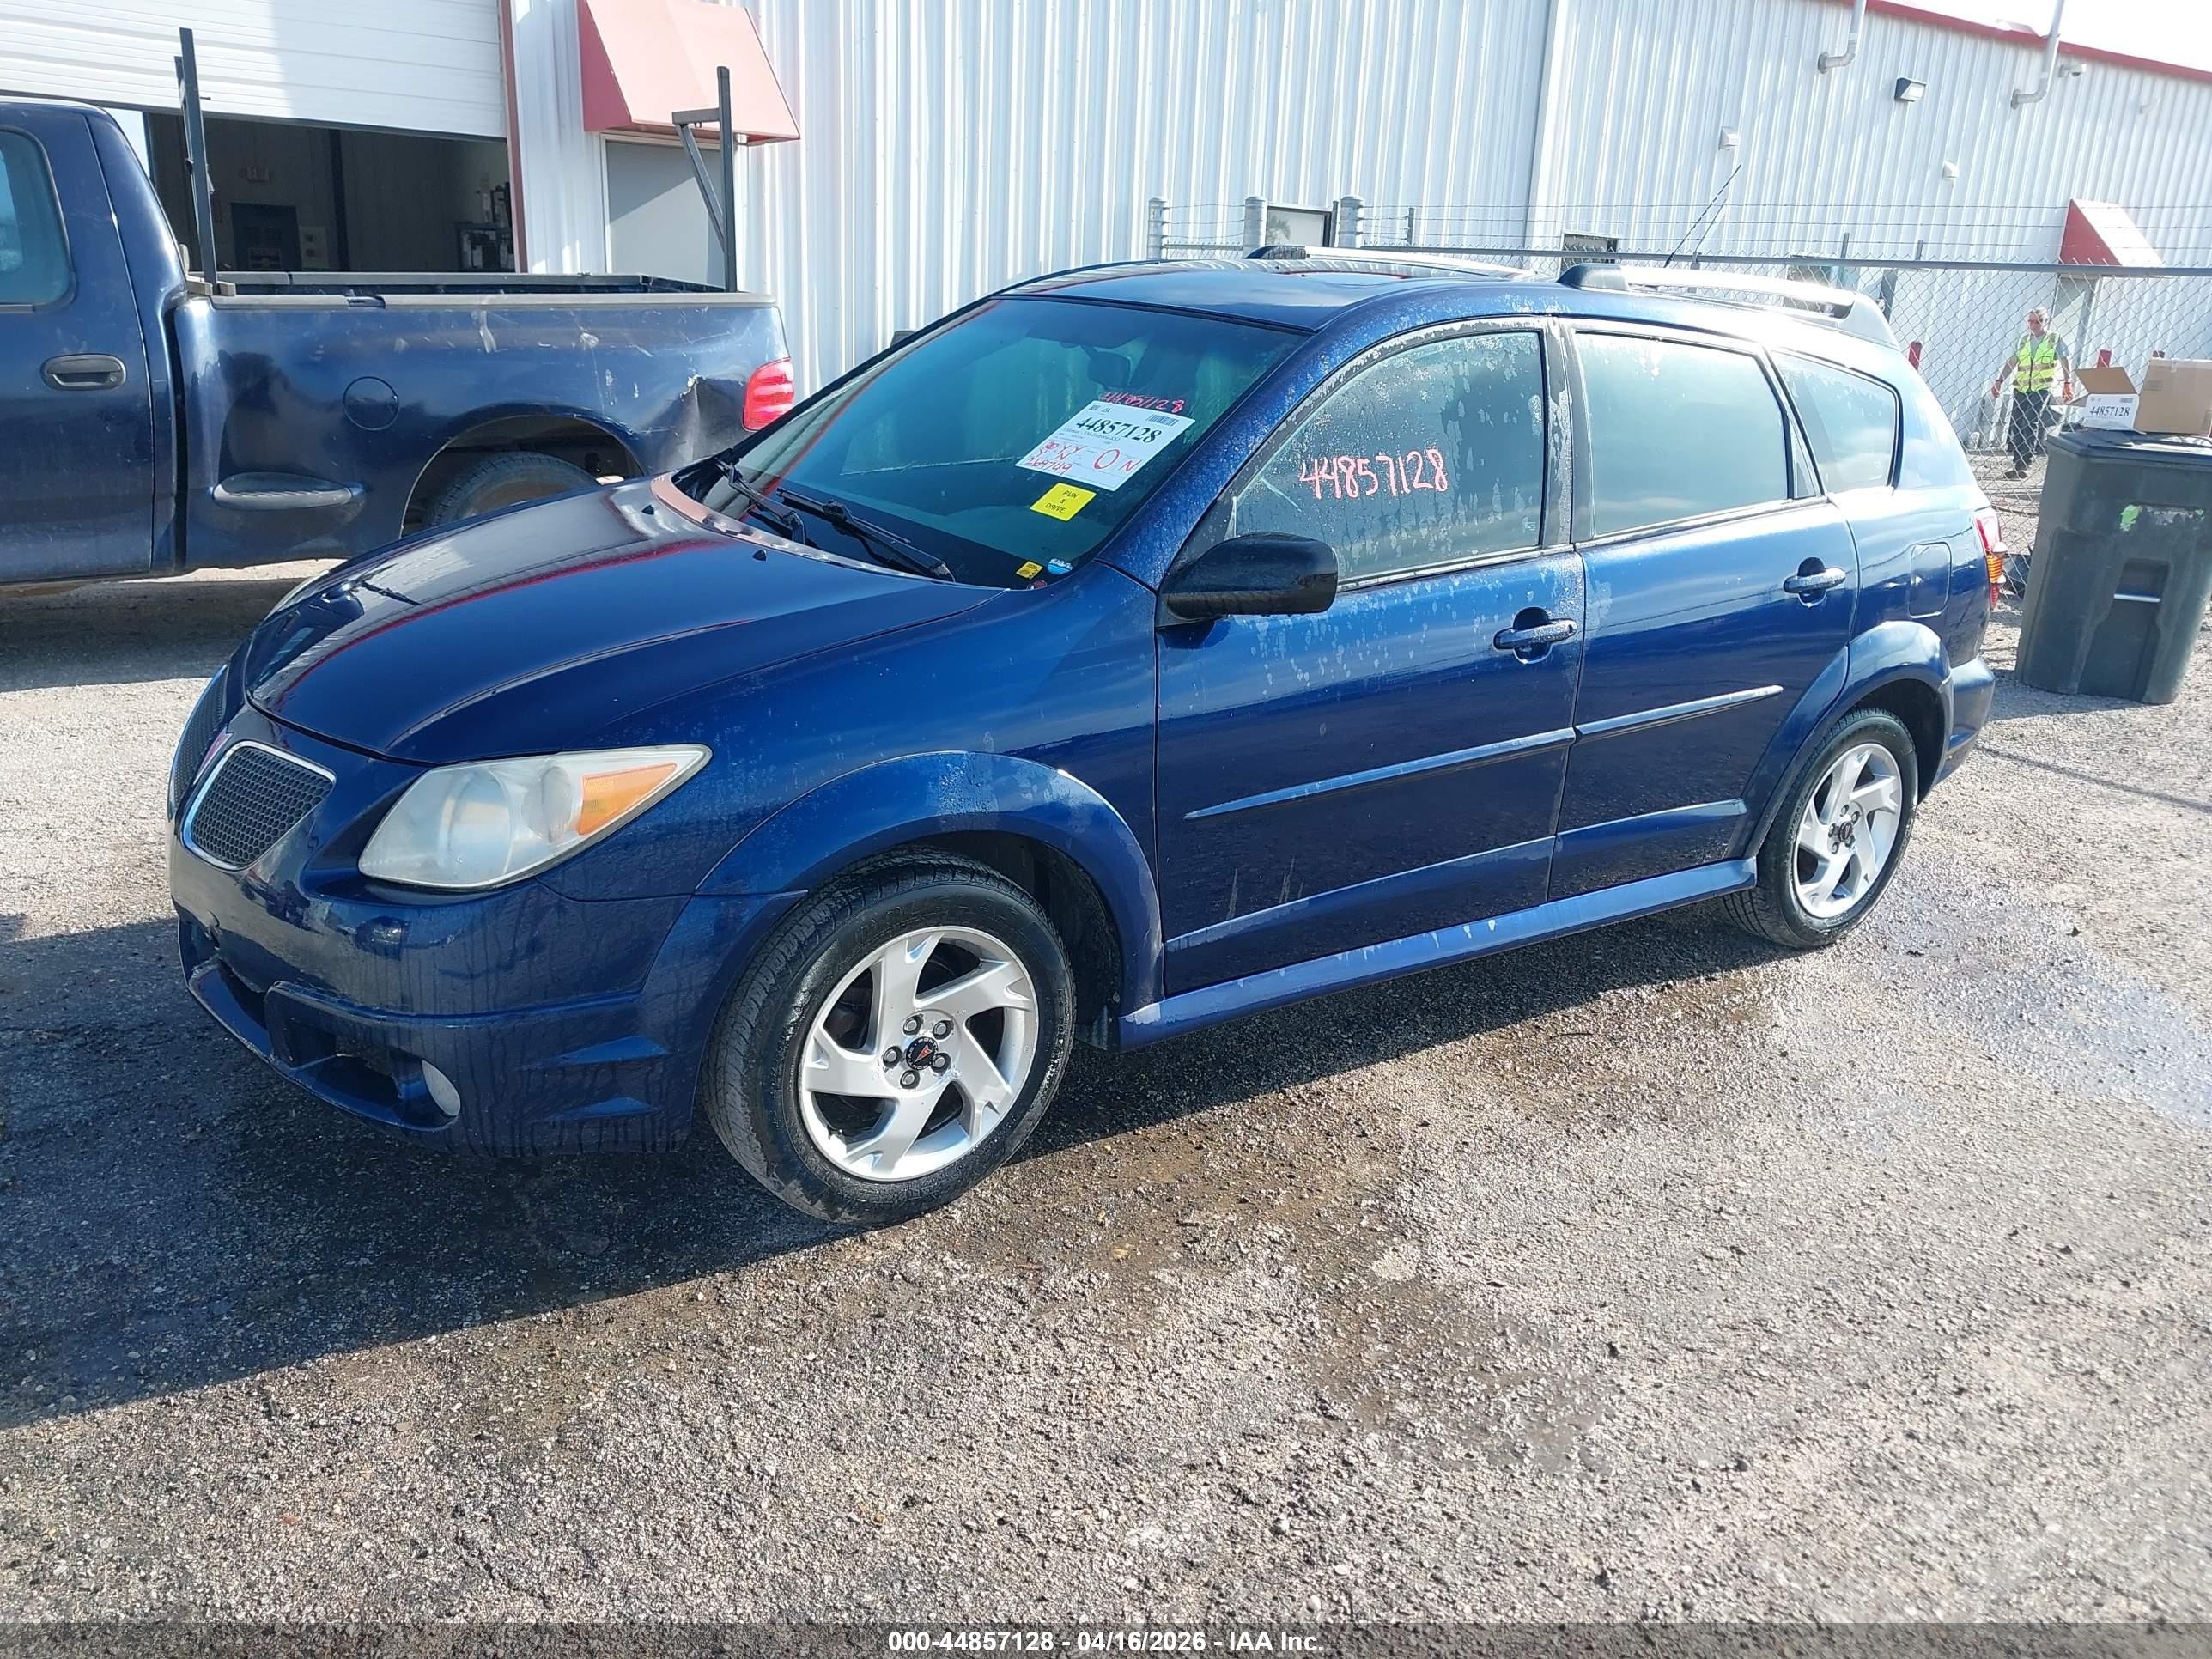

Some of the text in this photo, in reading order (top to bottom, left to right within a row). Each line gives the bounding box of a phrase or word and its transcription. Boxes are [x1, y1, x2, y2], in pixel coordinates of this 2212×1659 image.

[2089, 405, 2130, 417] 44857128
[1076, 416, 1162, 443] 44857128
[1299, 448, 1449, 500] 44857128
[1044, 502, 1066, 514] DRIVE
